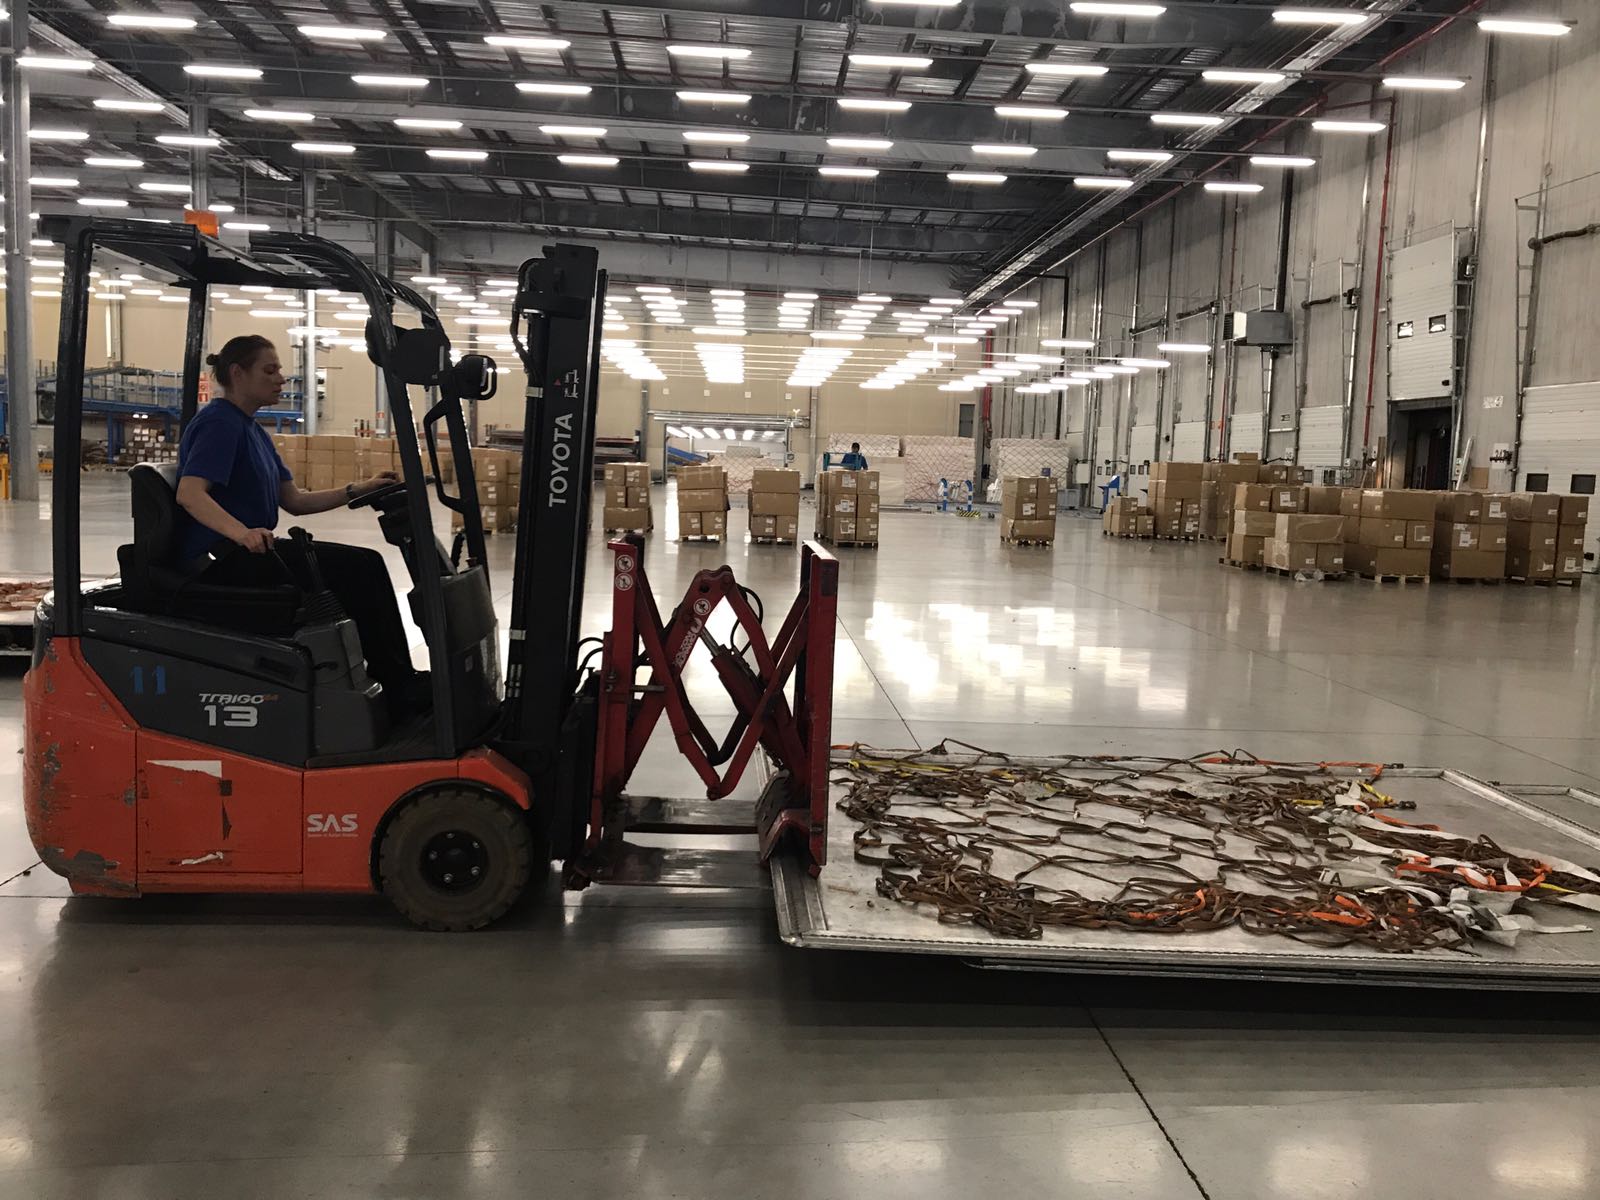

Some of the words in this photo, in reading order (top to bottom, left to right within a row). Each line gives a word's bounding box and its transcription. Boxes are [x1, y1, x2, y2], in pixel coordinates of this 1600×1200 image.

[548, 413, 573, 507] TOYOTA
[130, 666, 166, 695] 11
[204, 705, 258, 727] 13
[307, 814, 358, 832] SAS
